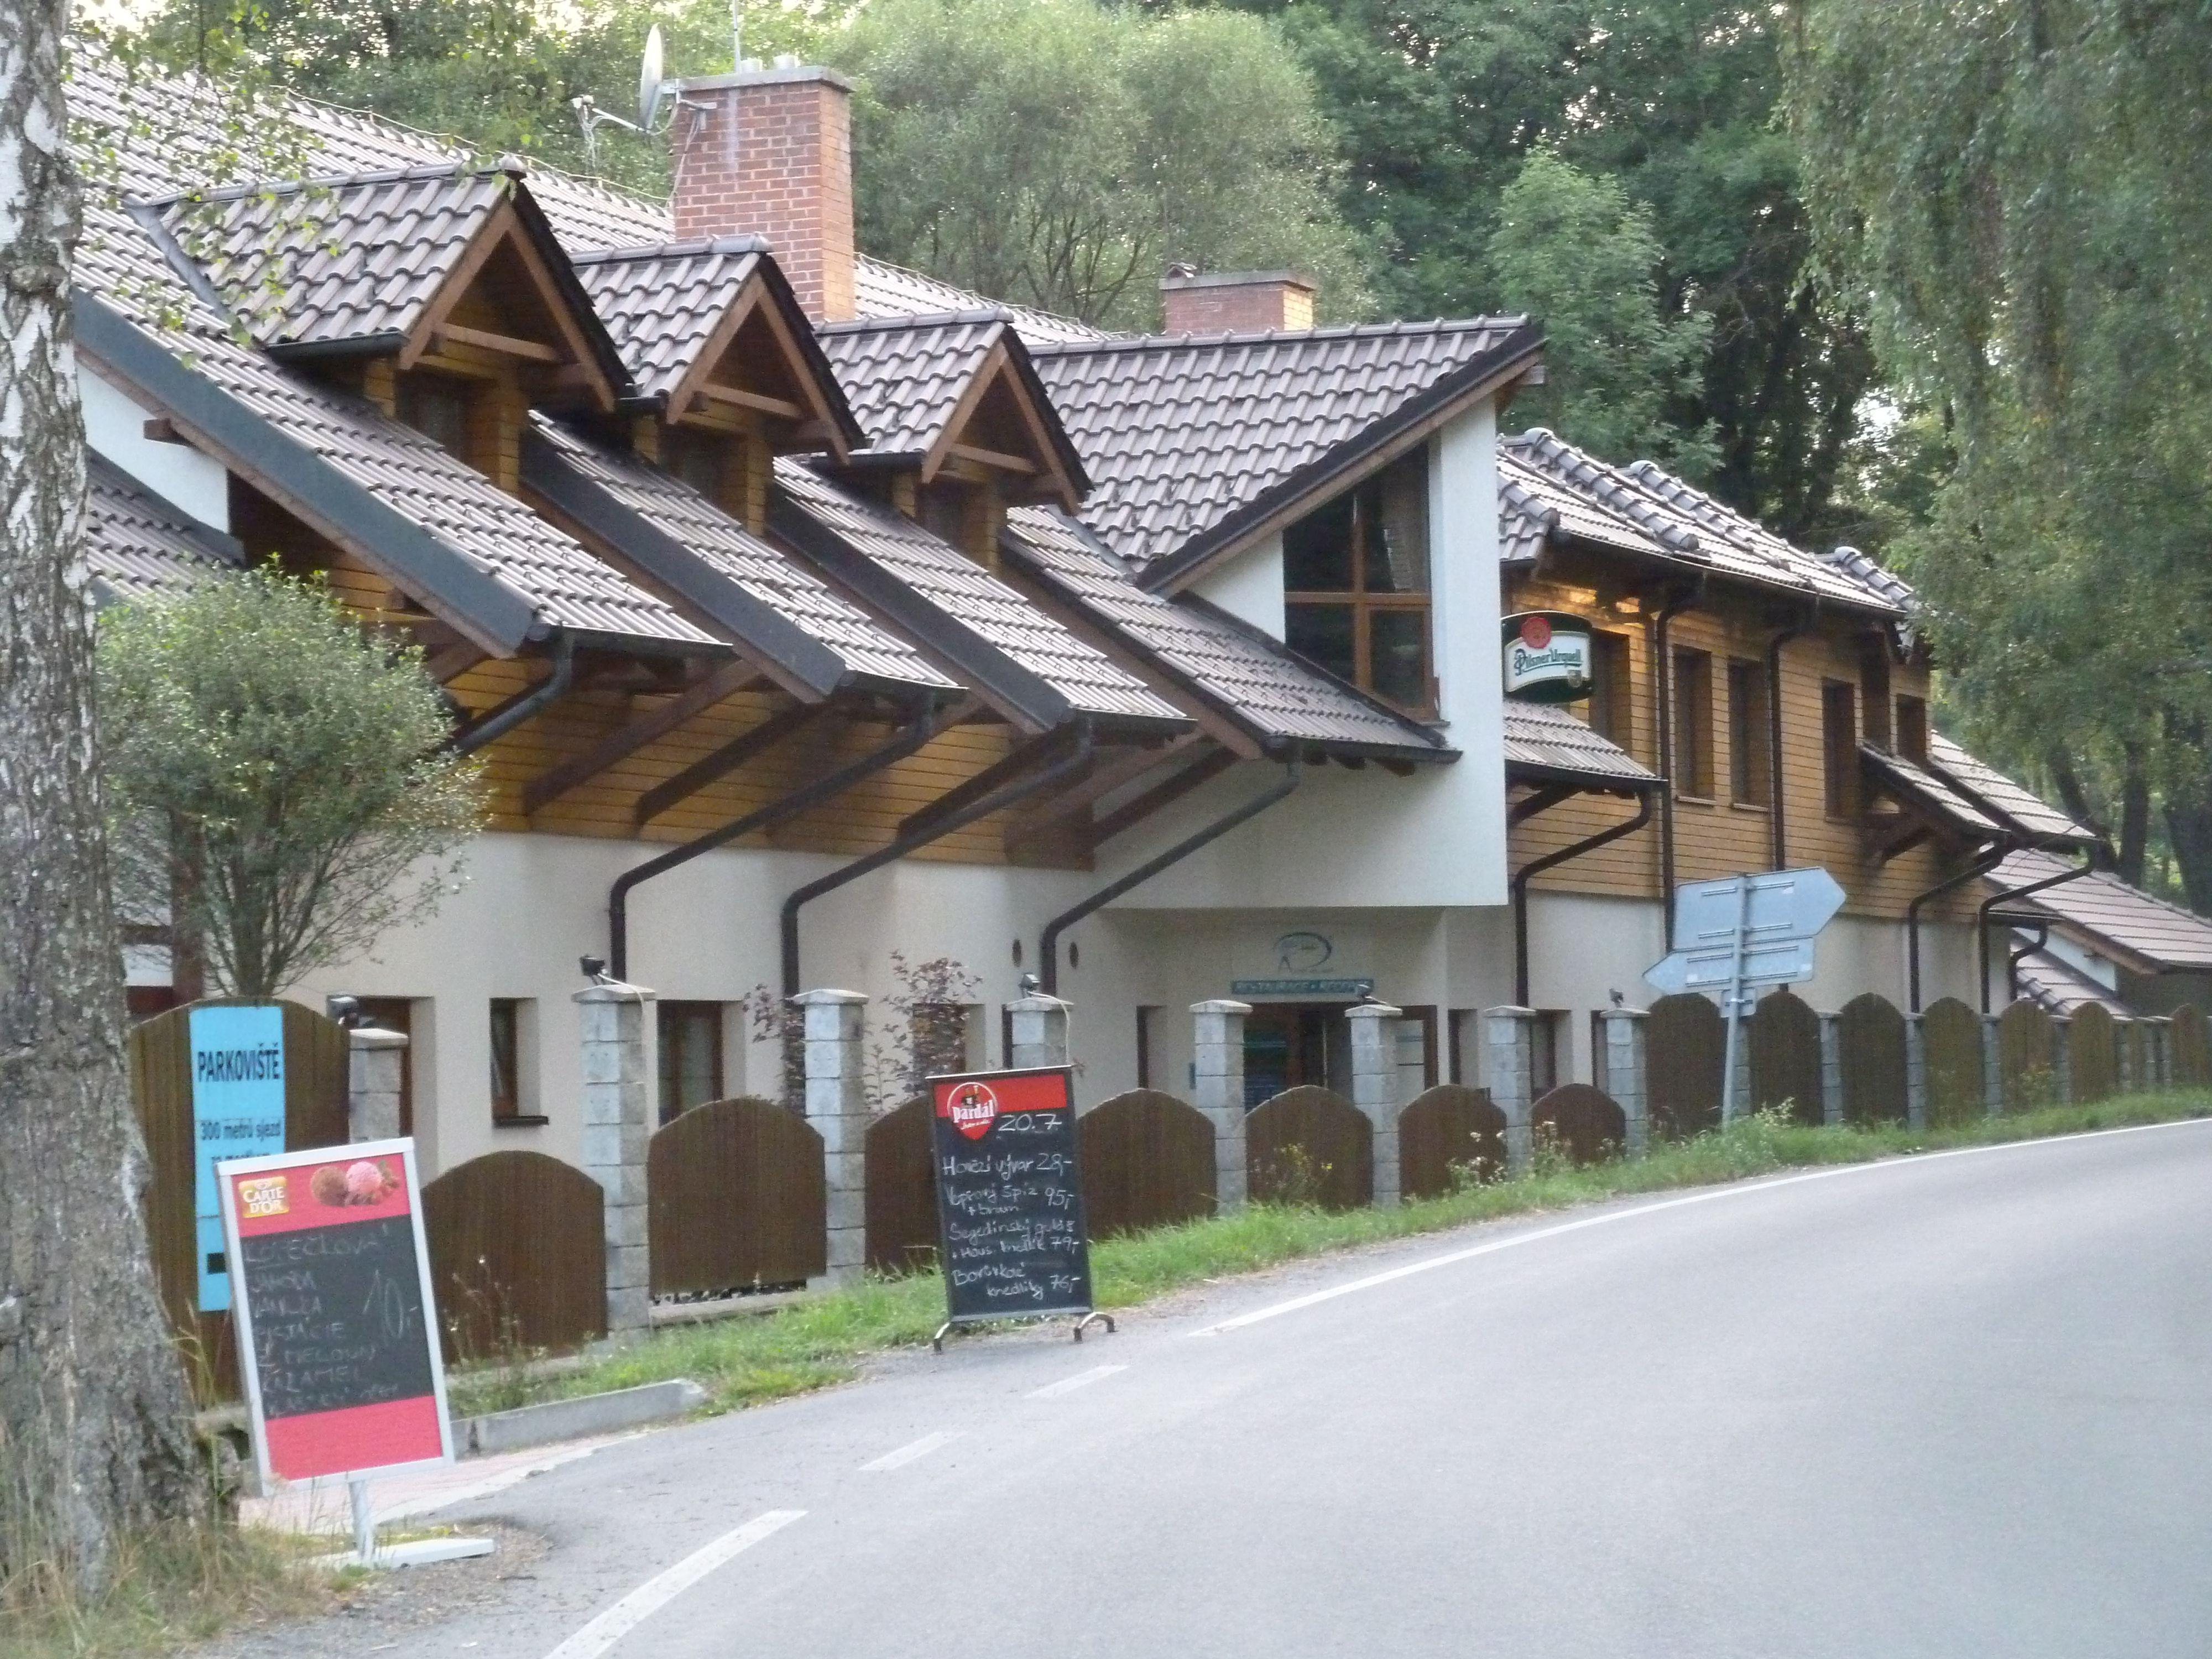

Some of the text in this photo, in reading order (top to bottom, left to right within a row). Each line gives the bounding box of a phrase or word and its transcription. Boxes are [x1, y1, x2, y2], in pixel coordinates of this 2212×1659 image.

[197, 1042, 280, 1082] PARKOVIŠTĚ
[201, 1121, 220, 1140] 300
[243, 1187, 285, 1203] CARTE
